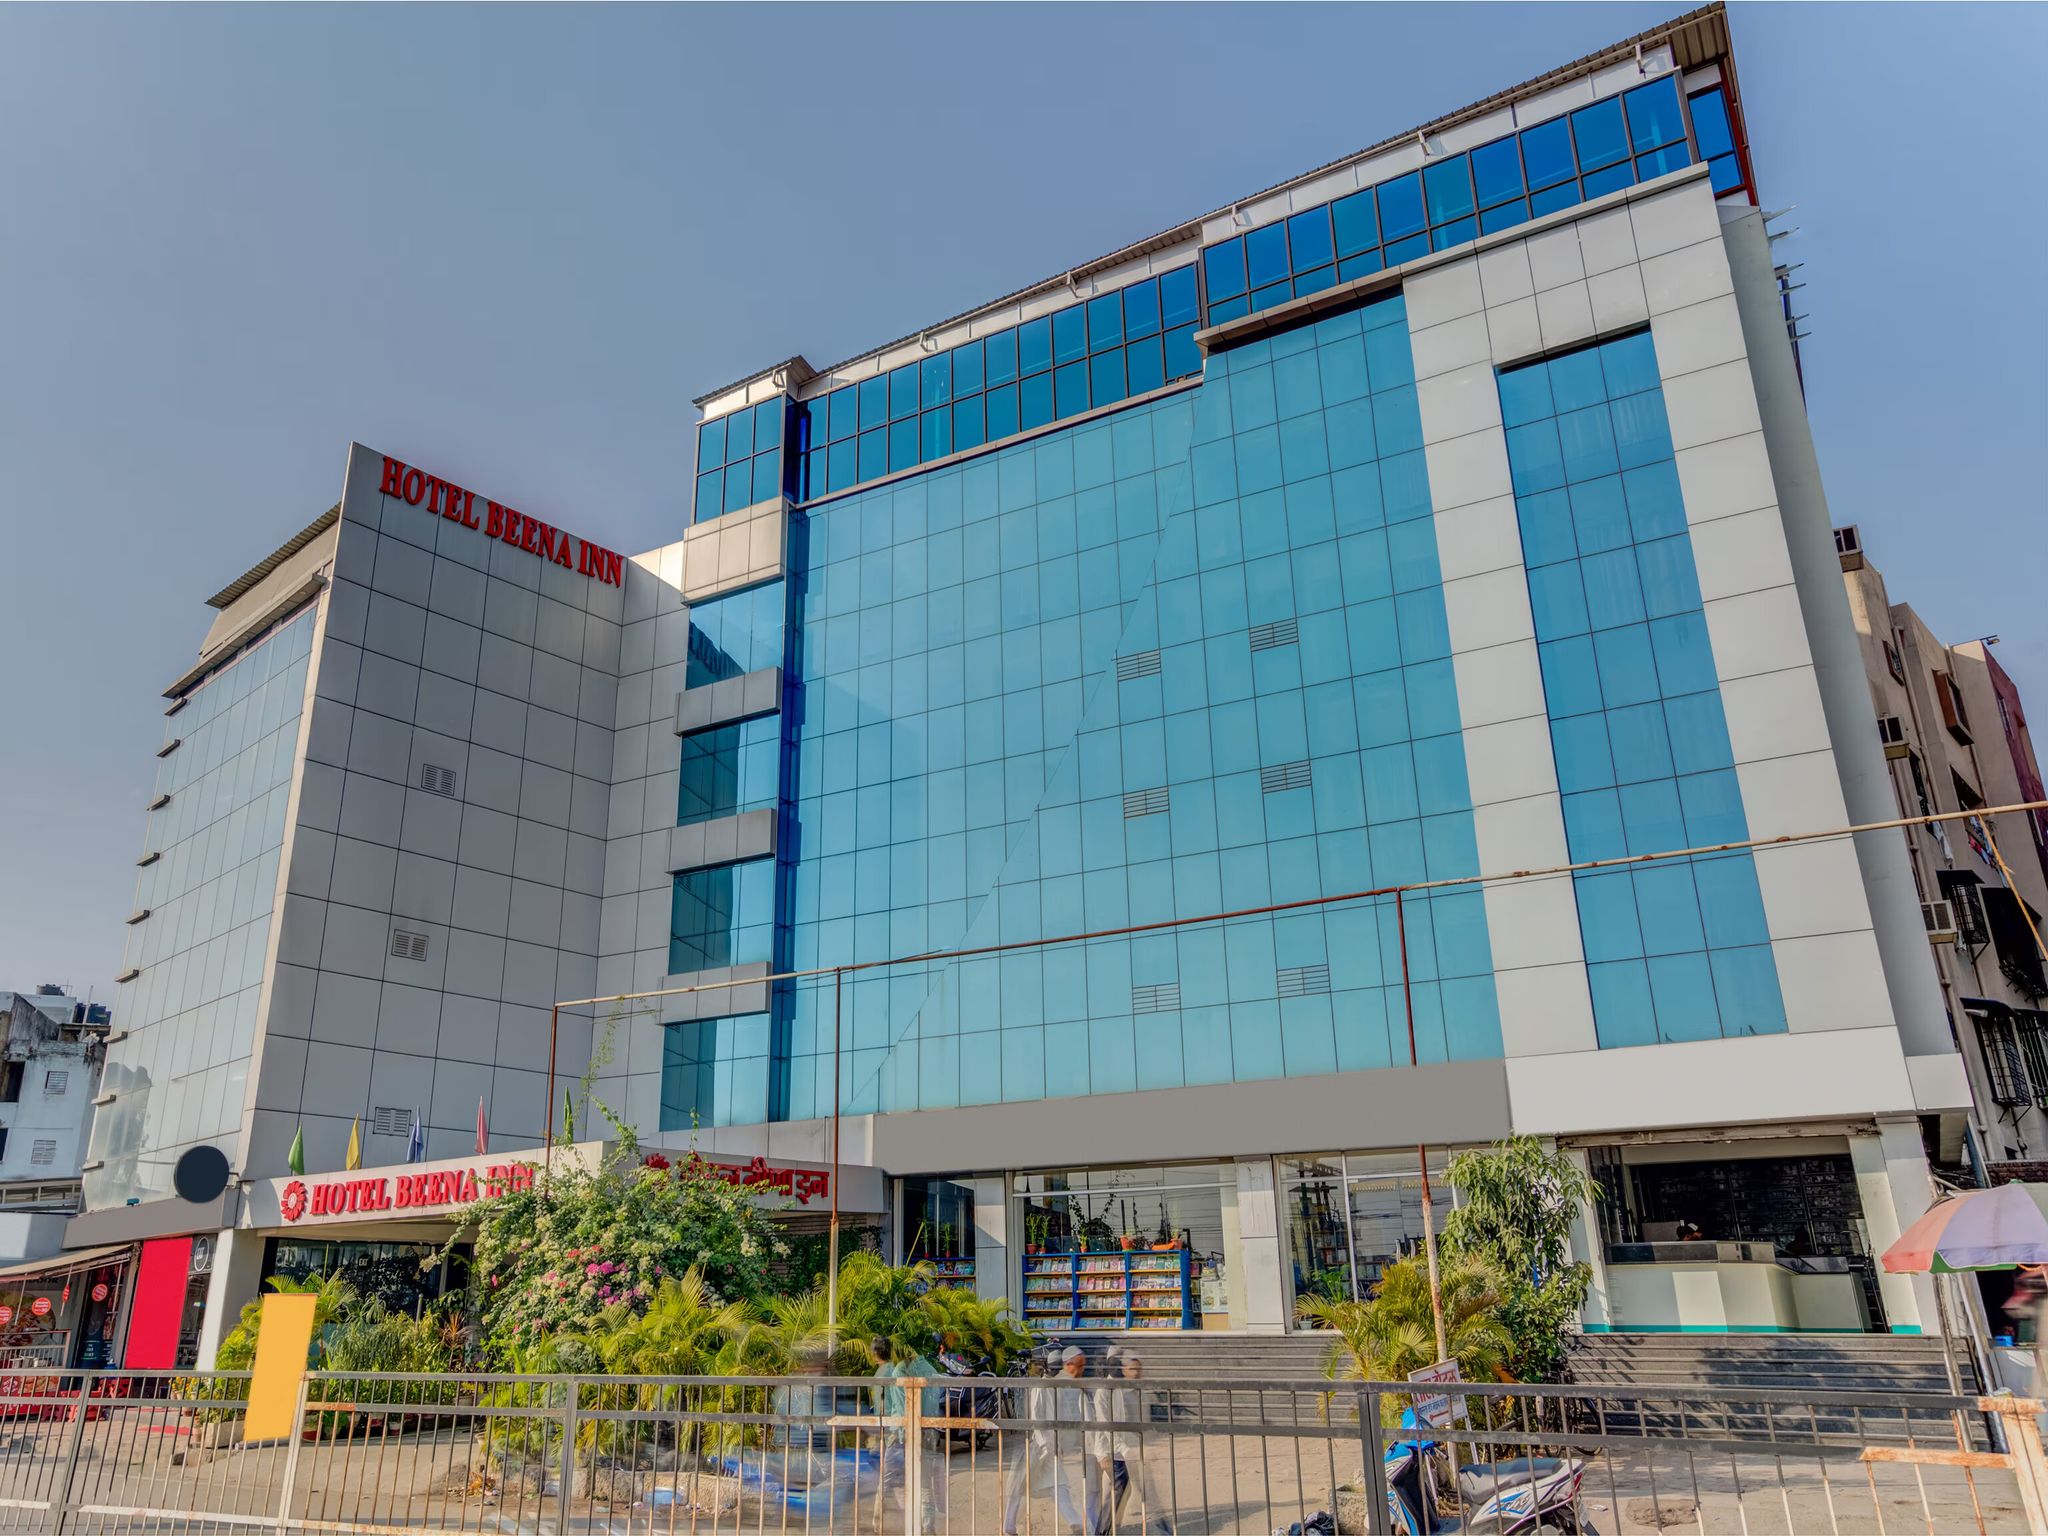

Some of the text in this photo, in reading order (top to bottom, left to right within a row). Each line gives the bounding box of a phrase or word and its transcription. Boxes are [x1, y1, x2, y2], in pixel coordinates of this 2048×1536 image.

[379, 455, 624, 588] HOTEL BEENA INN
[310, 1164, 534, 1215] HOTEL BEENA INN
